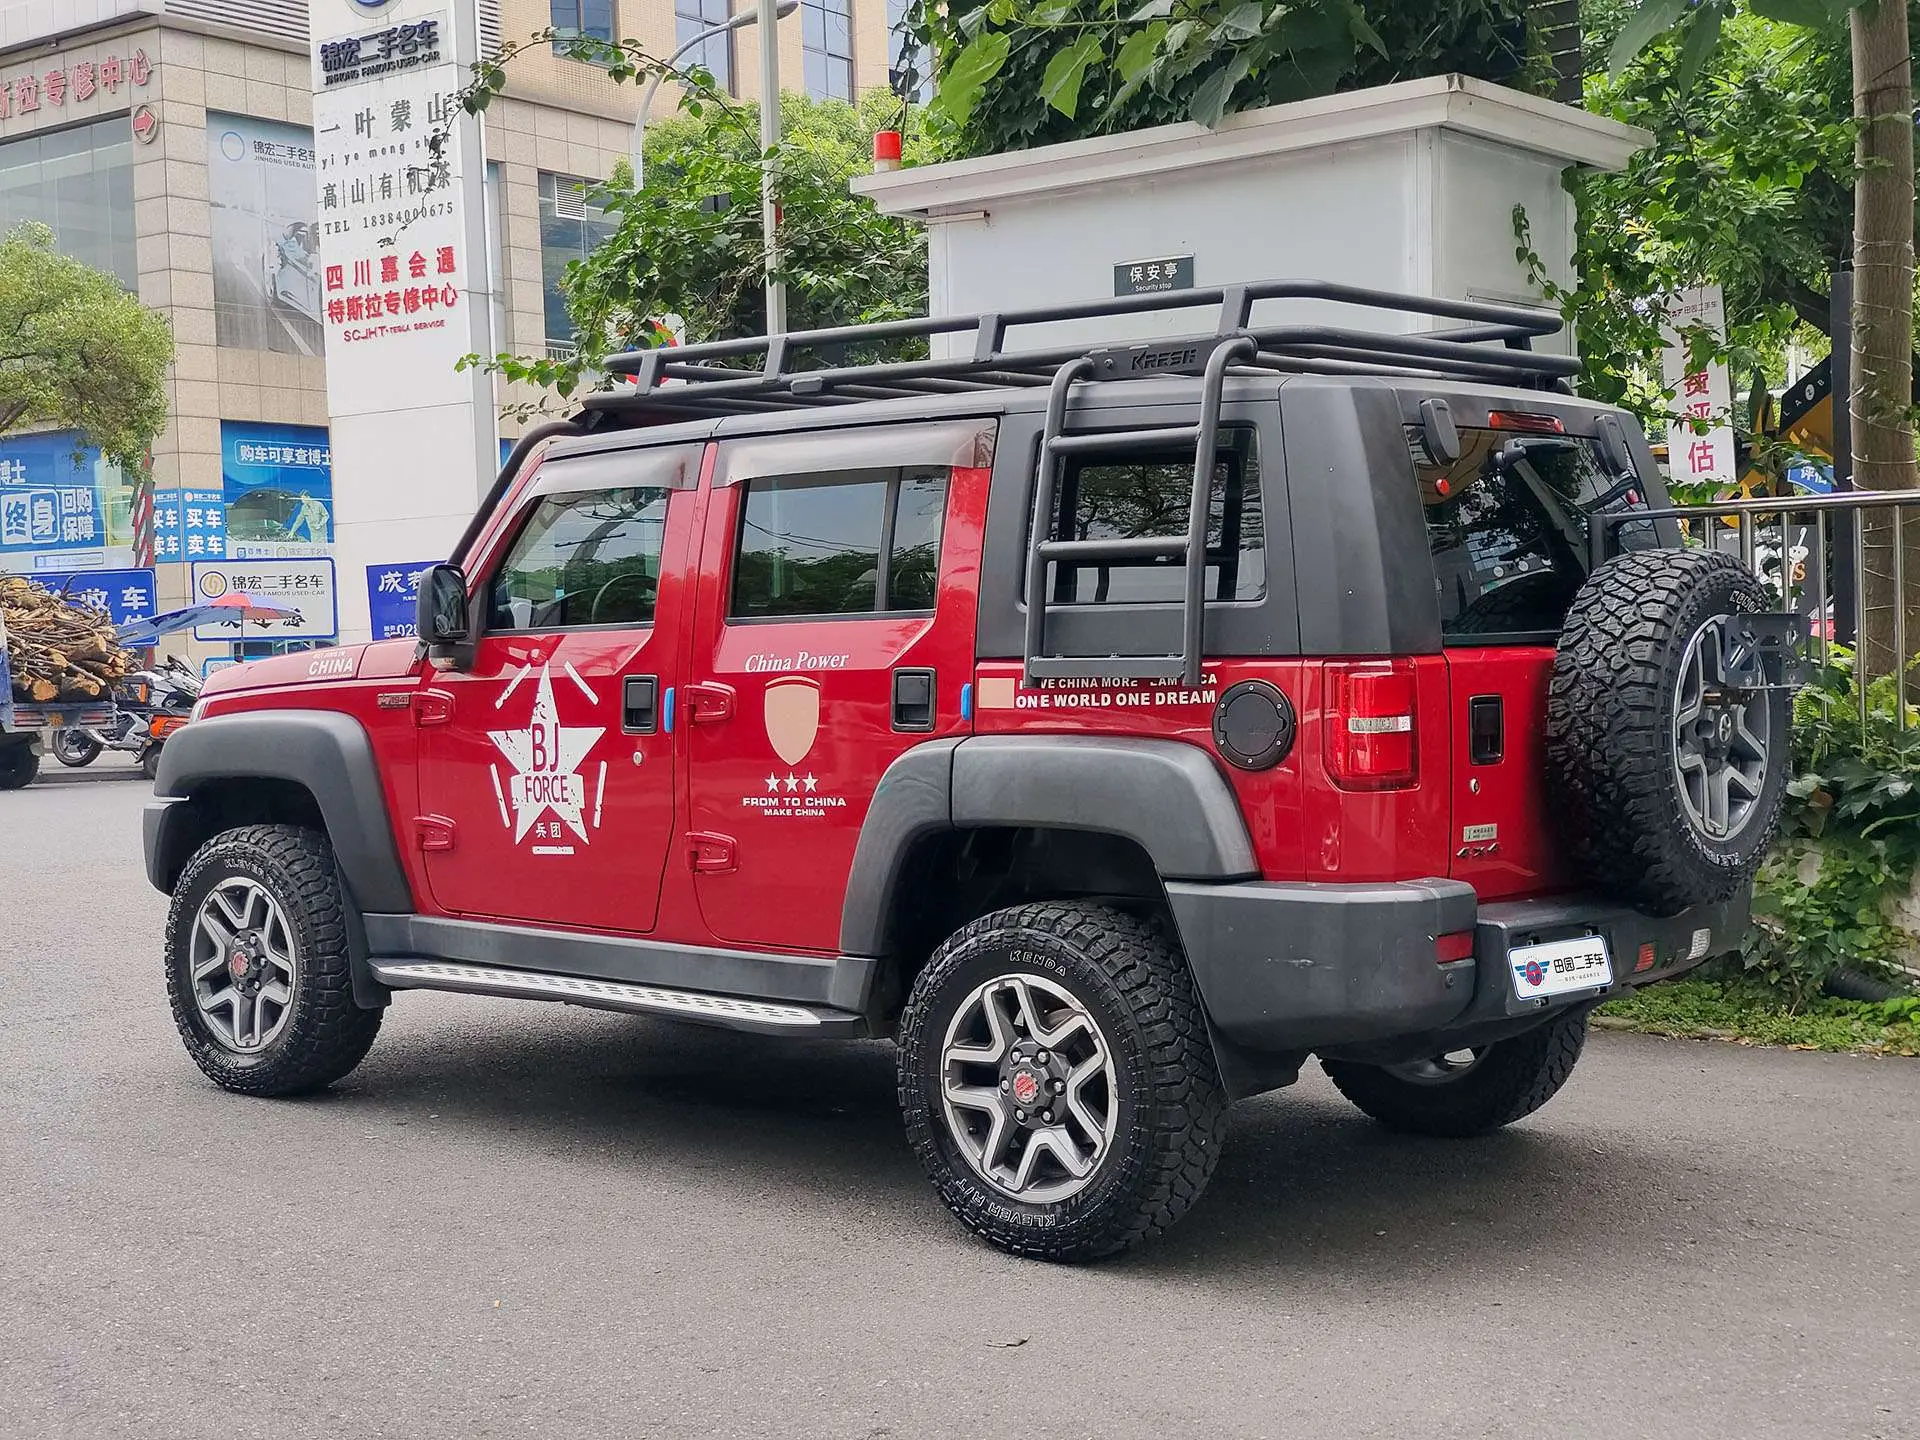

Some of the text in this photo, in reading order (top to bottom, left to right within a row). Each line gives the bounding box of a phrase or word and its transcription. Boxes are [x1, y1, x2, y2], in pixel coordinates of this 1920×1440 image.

[320, 20, 440, 72] 锦宏二手名车
[320, 93, 448, 139] 一叶蒙山
[322, 153, 335, 170] yi
[415, 133, 449, 149] shn
[325, 202, 453, 235] TEL 18384000675
[326, 246, 456, 291] 四川嘉会通
[1130, 262, 1178, 284] 保安亭
[327, 282, 458, 324] 特斯拉专修中心
[61, 487, 92, 514] 回购
[6, 498, 56, 537] 终身
[62, 515, 94, 542] 保障
[187, 508, 222, 529] 买车
[188, 534, 223, 555] 卖车
[231, 574, 325, 590] 锦宏二手名车
[309, 657, 353, 675] CHINA
[745, 651, 849, 673] China Power
[1058, 678, 1098, 688] CHINA
[1016, 690, 1216, 709] ONE WORLD ONE DREAM
[532, 722, 559, 773] BJ
[525, 775, 569, 803] FORCE
[743, 797, 847, 807] FROM TO CHINA
[764, 808, 825, 816] MAKE CHINA
[1010, 950, 1066, 977] KENDA
[1553, 953, 1605, 973] 田园二手车
[988, 1202, 1055, 1227] KLEVER
